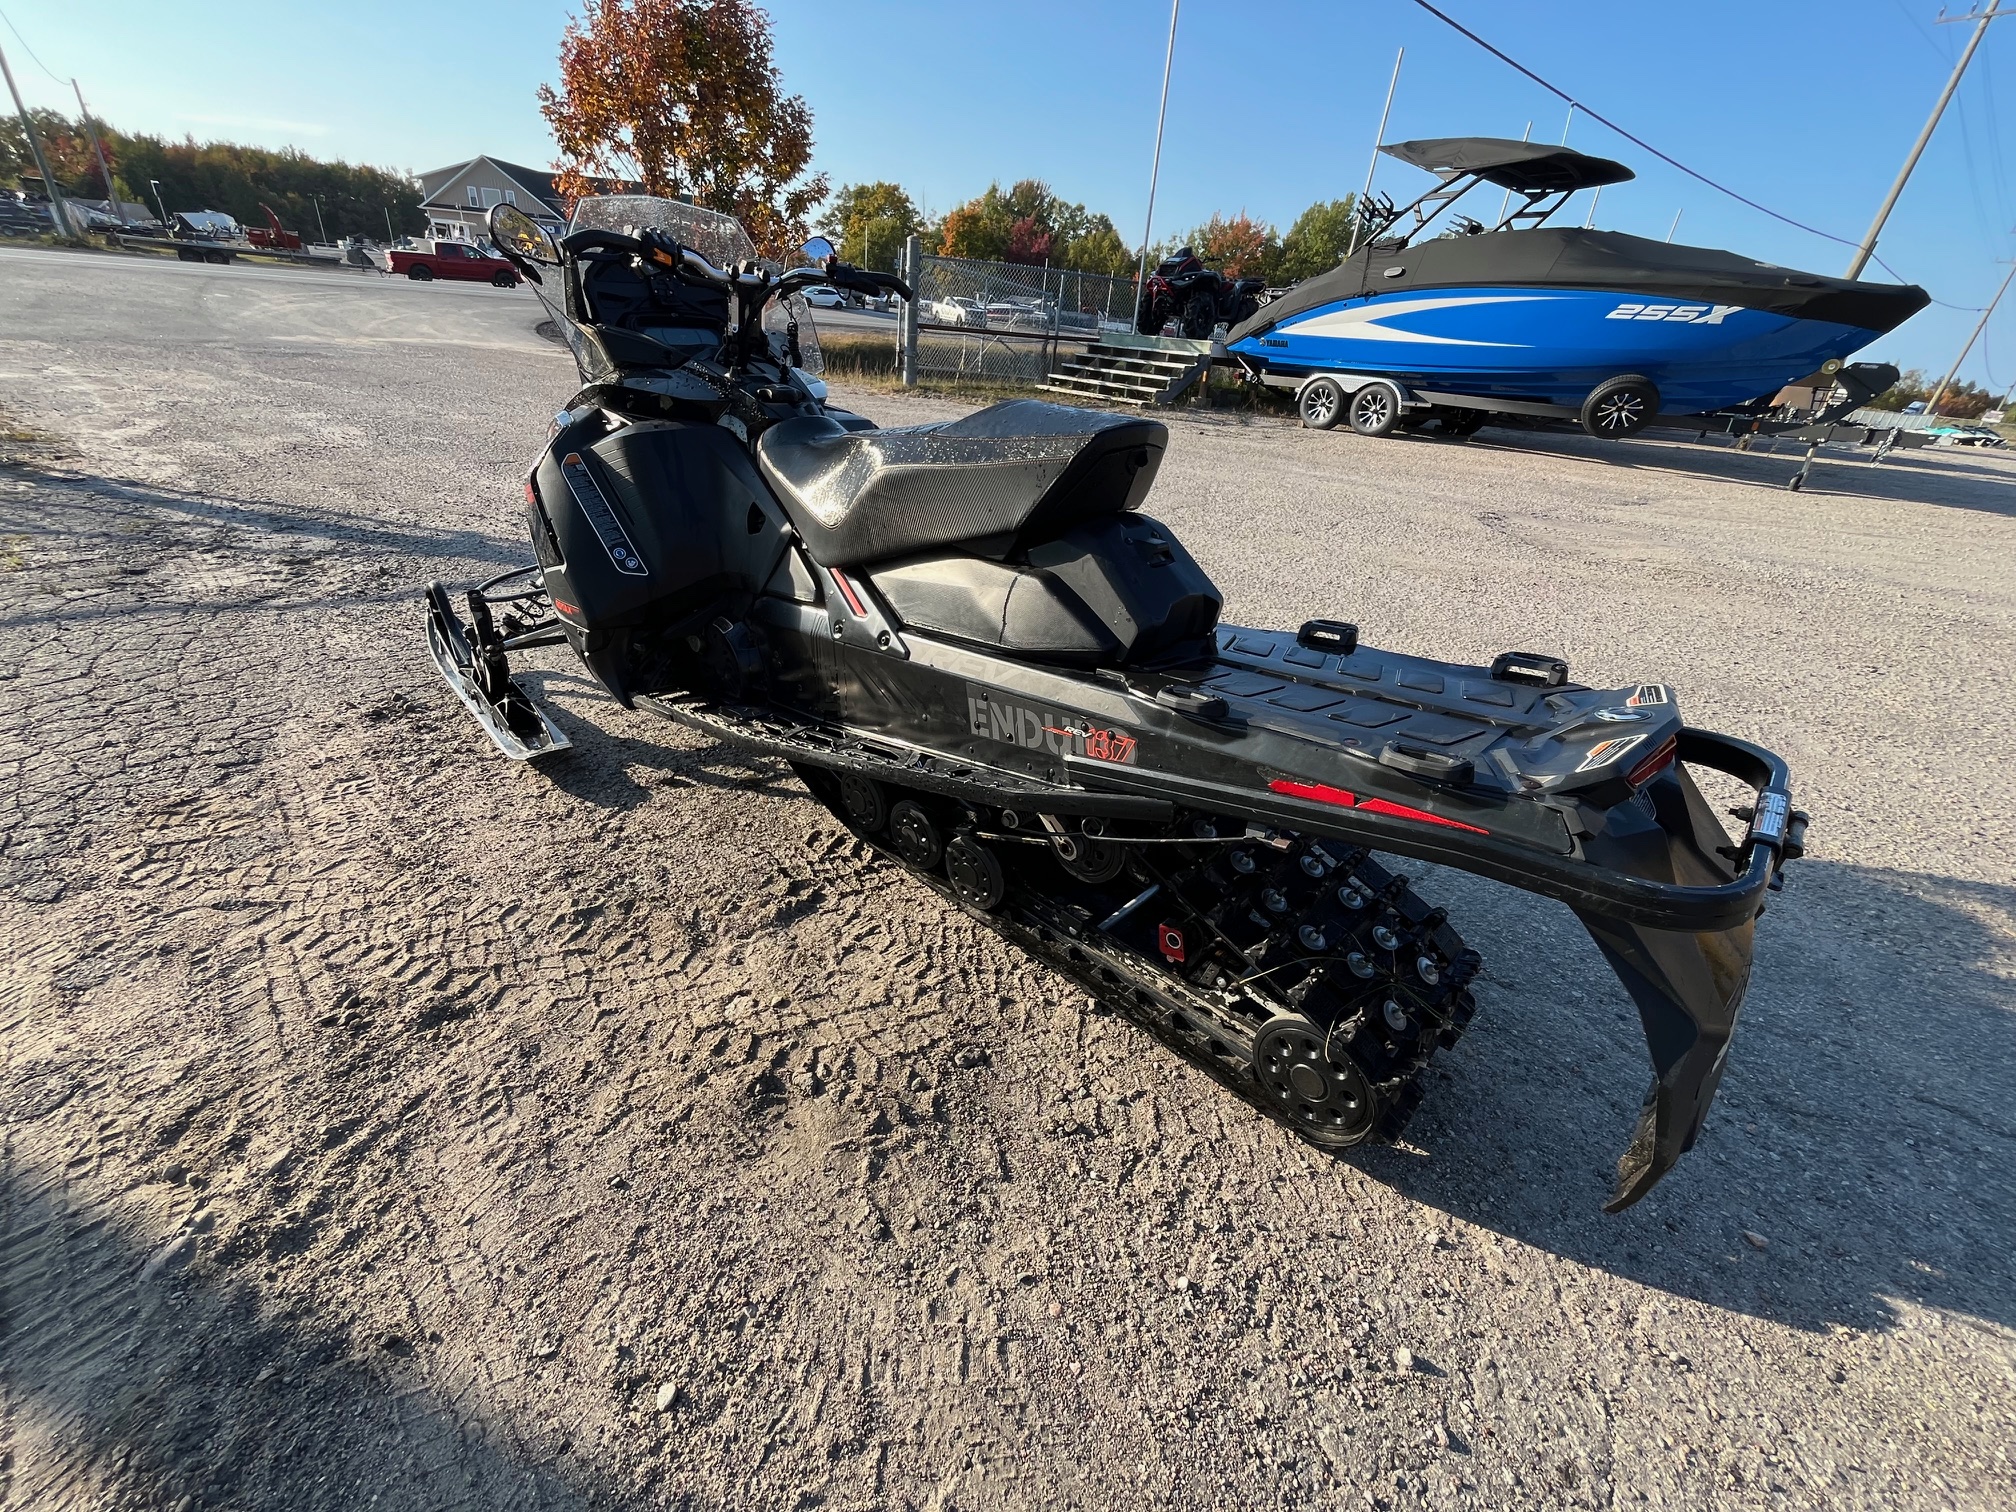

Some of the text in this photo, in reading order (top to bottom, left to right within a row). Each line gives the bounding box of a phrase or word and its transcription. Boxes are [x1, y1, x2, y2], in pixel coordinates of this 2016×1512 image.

[1604, 303, 1745, 325] 255X
[1064, 725, 1094, 738] REV
[1086, 727, 1136, 763] 137
